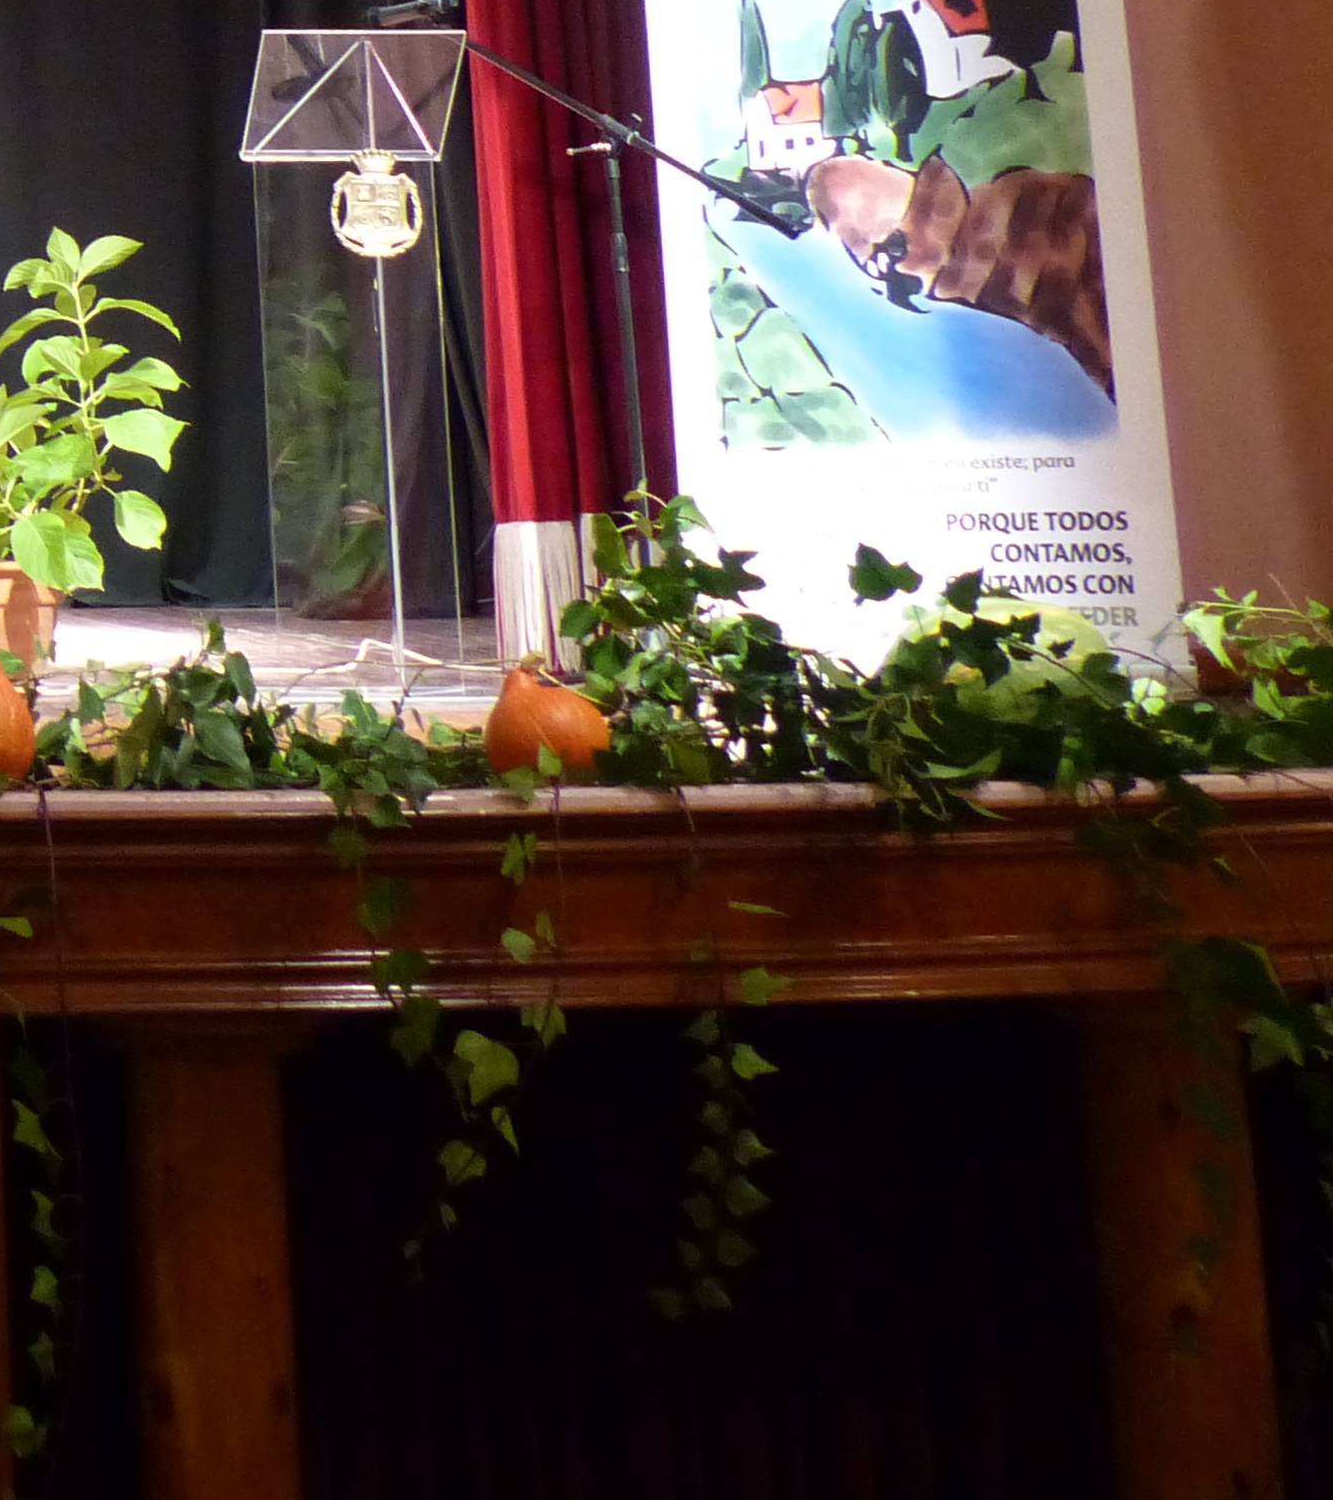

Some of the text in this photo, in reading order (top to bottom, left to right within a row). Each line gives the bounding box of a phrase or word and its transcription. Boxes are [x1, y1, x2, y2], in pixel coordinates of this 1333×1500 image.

[1033, 456, 1076, 472] para
[946, 511, 1129, 534] PORQUE TODOS
[990, 543, 1133, 565] CONTAMOS,
[953, 574, 1135, 594] NTAMOS CON
